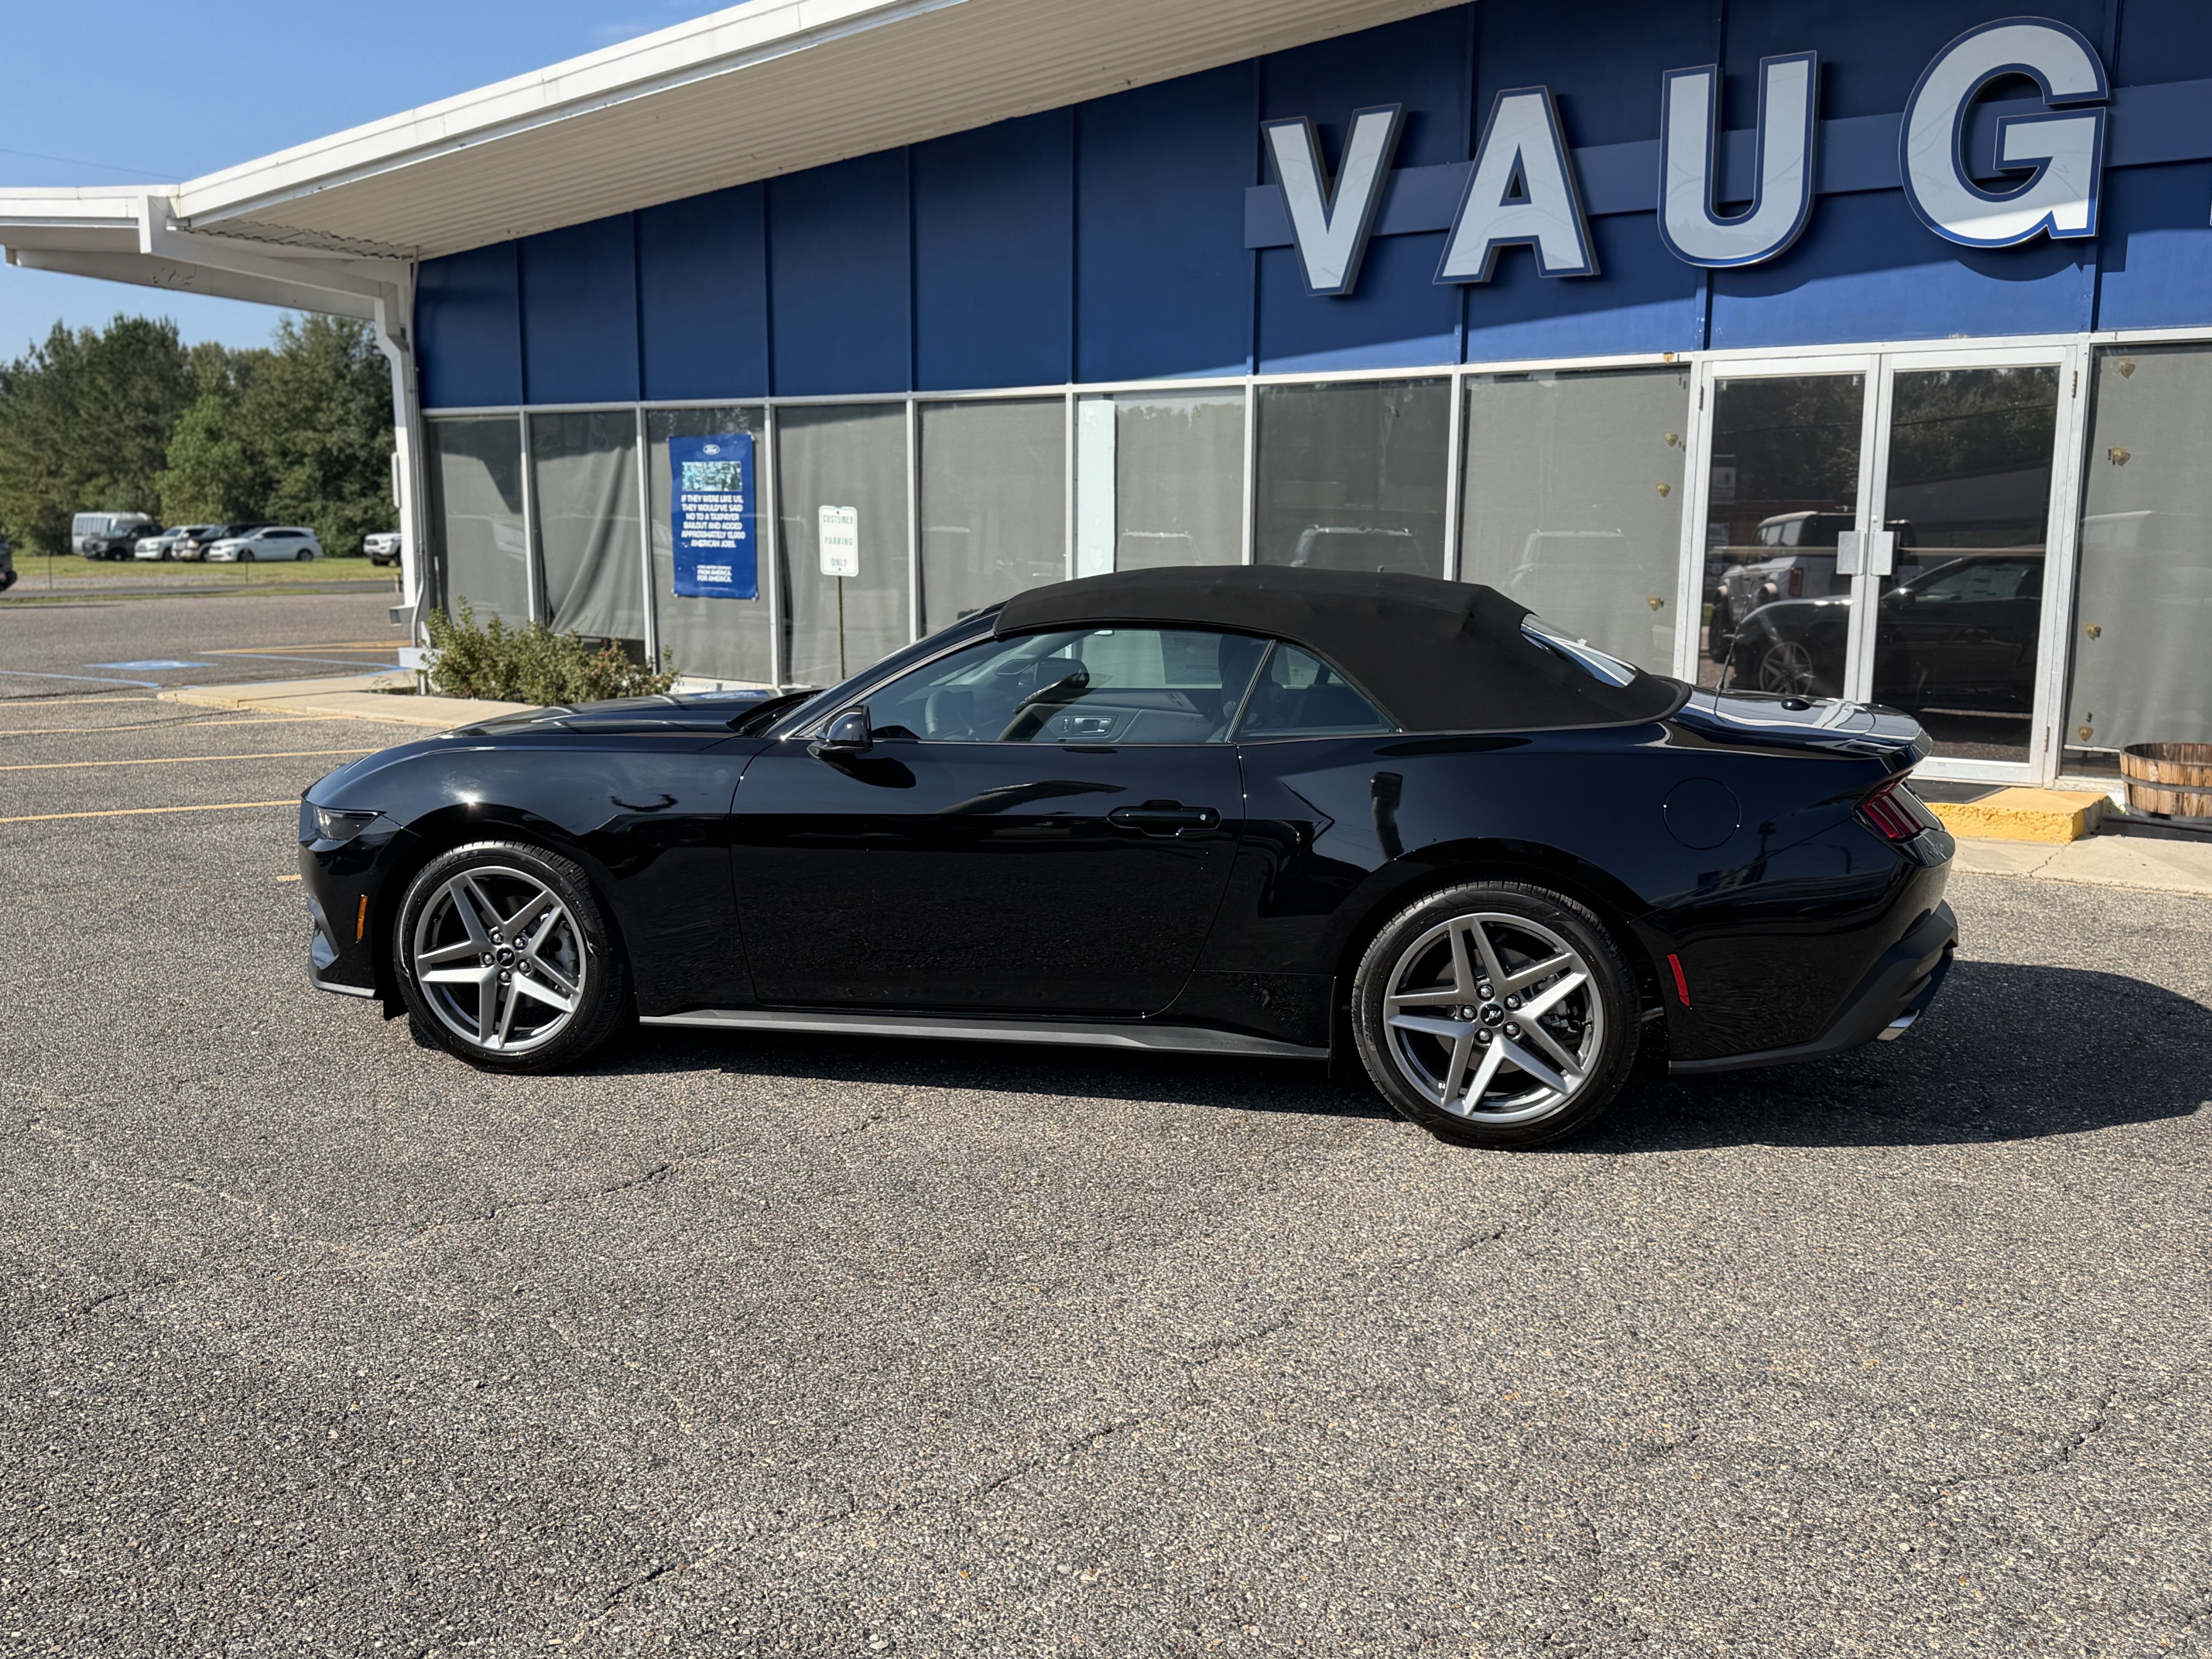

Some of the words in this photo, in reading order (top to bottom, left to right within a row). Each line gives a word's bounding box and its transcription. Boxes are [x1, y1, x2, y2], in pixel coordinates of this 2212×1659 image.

[1260, 15, 2212, 296] VAUG
[823, 515, 853, 524] CUSTOMER
[824, 536, 853, 546] PARKING
[831, 558, 847, 567] ONLY
